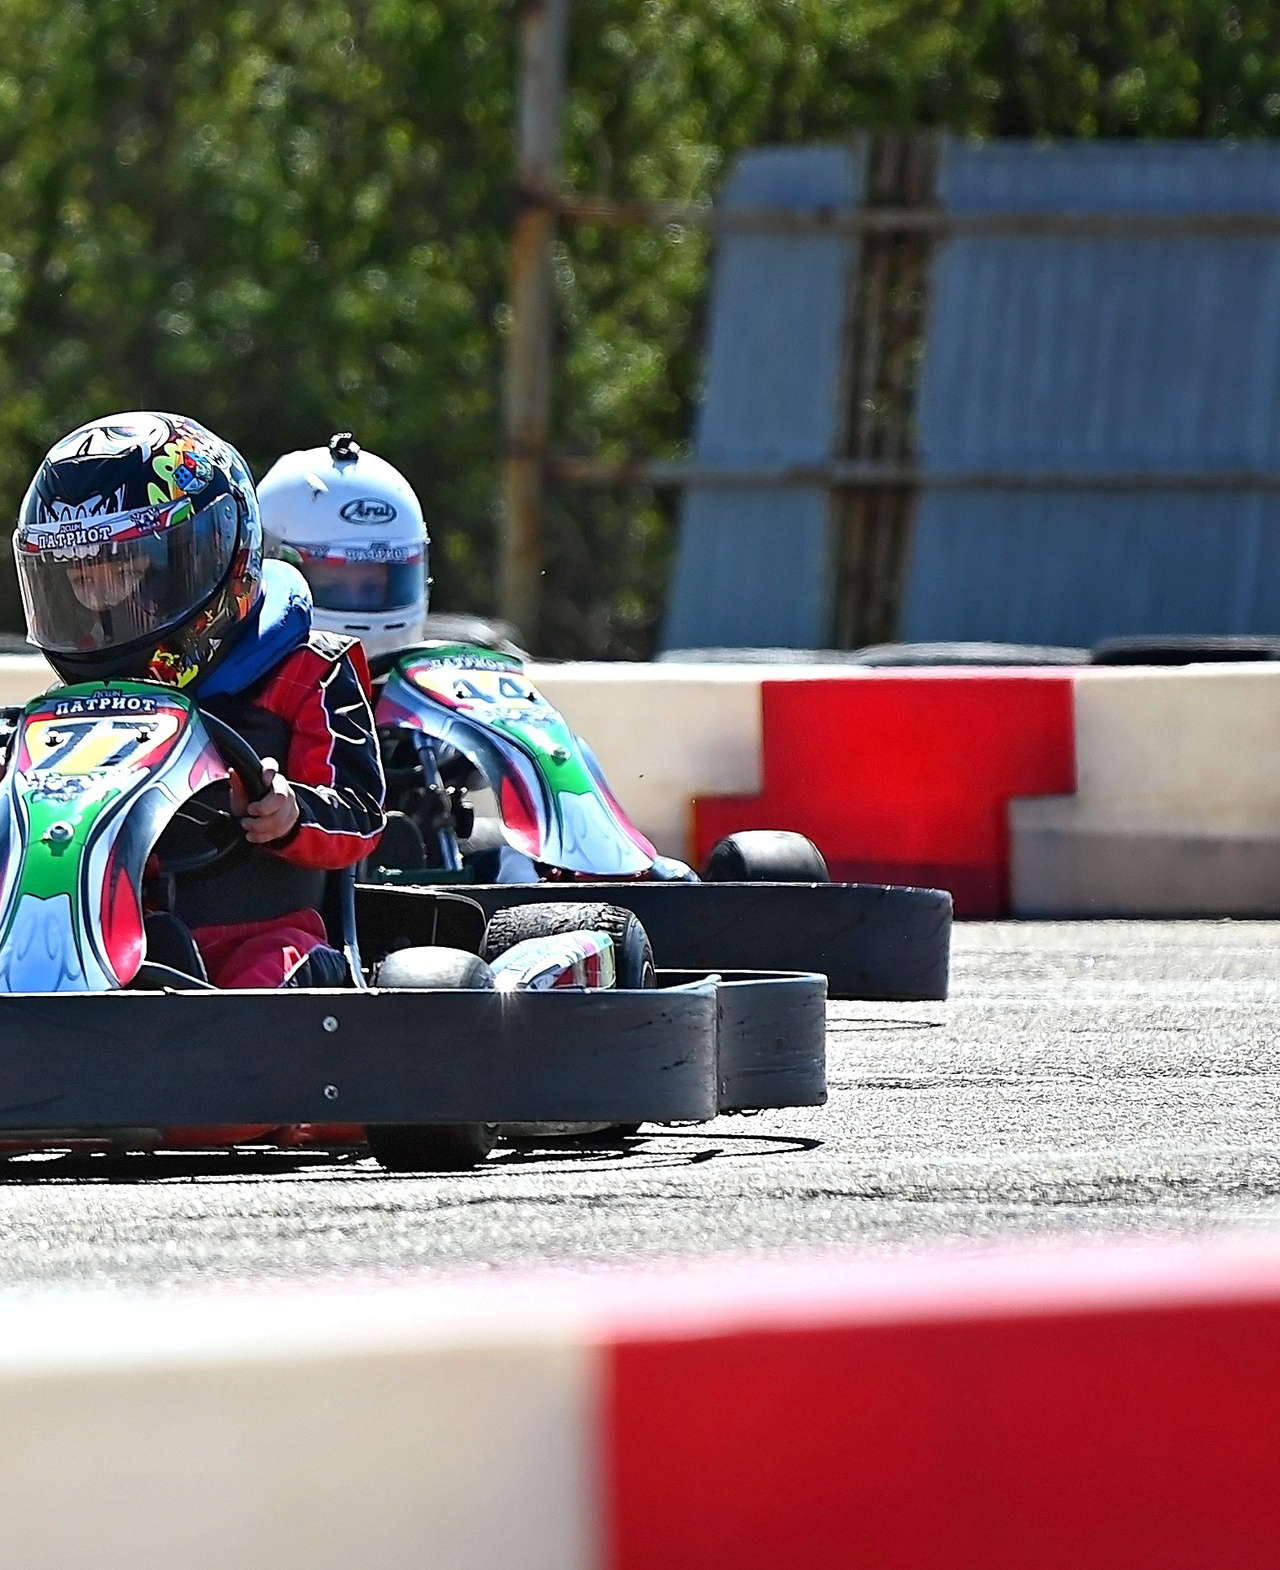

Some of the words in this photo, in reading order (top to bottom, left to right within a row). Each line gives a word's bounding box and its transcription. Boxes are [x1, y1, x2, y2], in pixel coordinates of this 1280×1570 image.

[349, 500, 391, 518] Arai
[38, 527, 112, 549] ПАТРИОТ
[55, 698, 156, 715] ПАТРИОТ
[34, 719, 159, 770] 77
